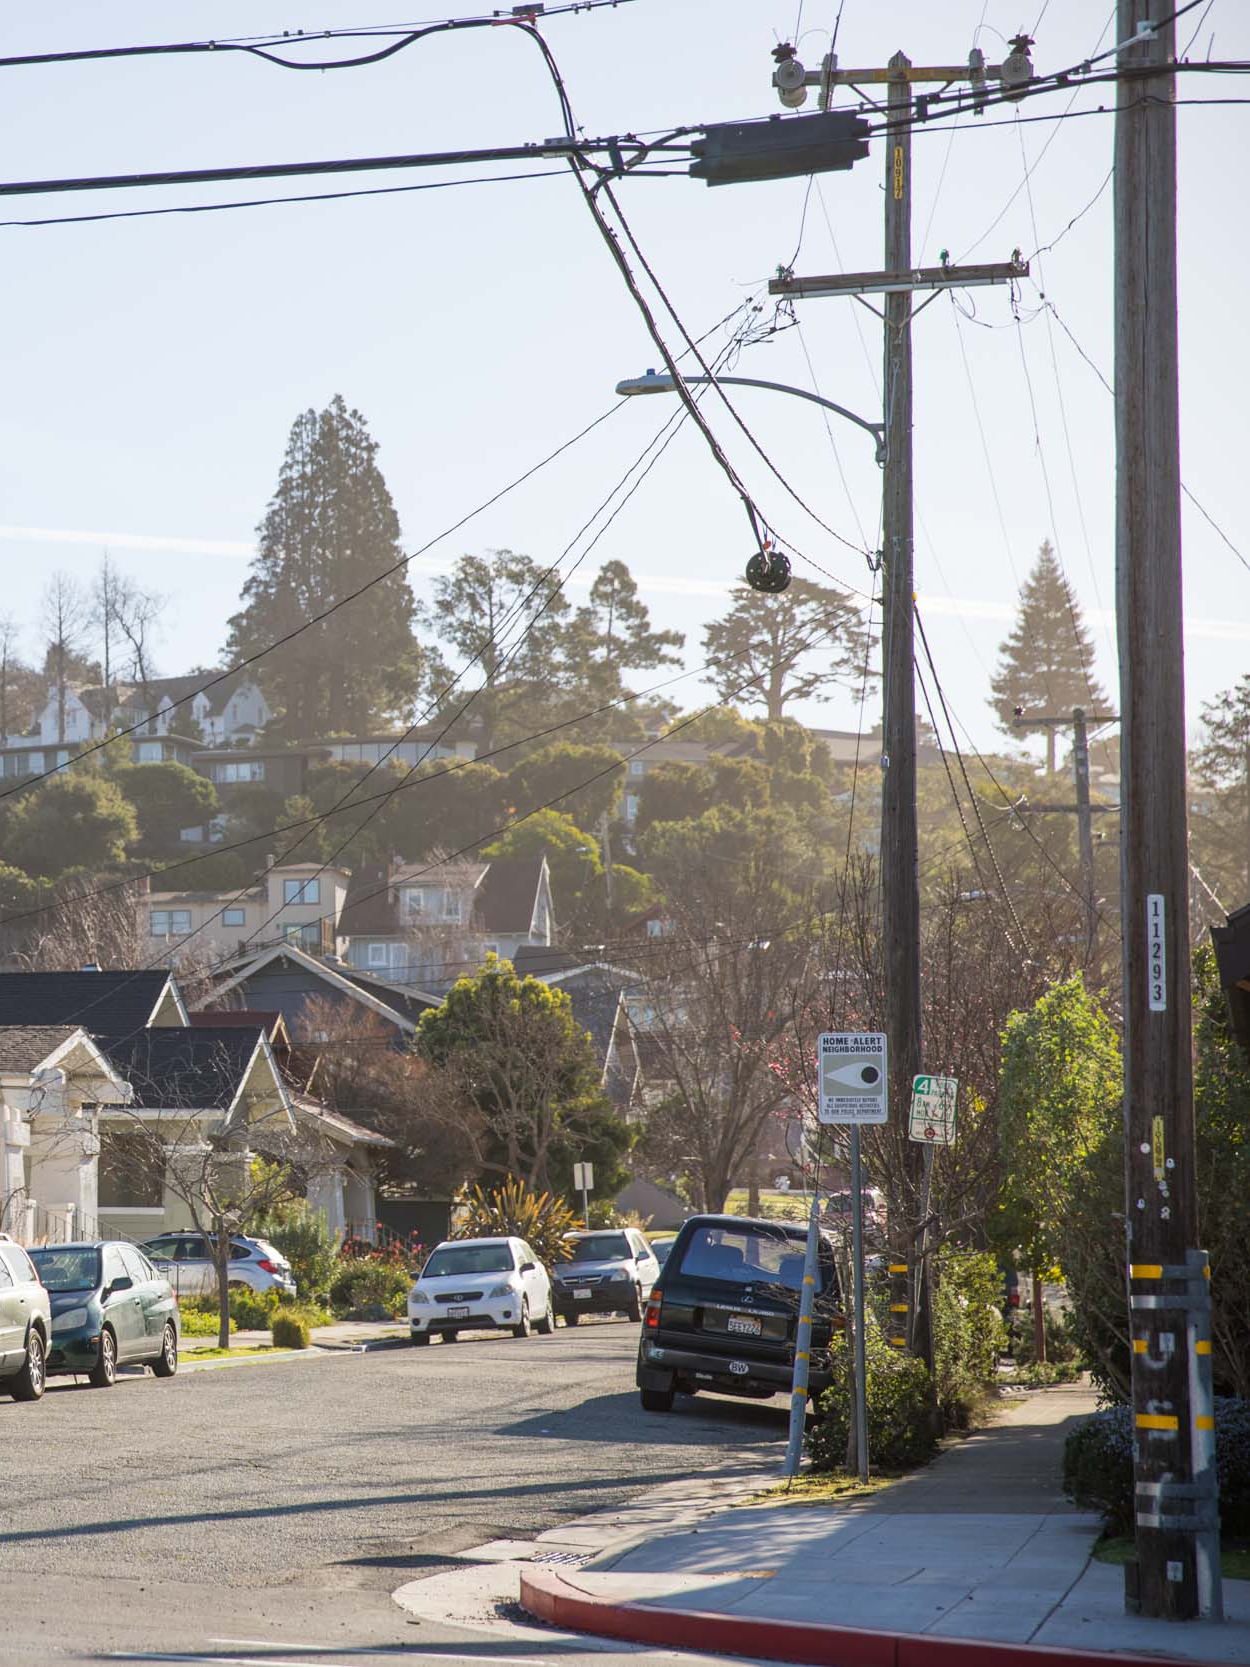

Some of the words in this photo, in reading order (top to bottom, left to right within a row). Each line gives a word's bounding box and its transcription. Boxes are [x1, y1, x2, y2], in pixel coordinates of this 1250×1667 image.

[1152, 901, 1162, 1001] 11293
[823, 1037, 849, 1045] HOME
[853, 1037, 882, 1045] ALERT
[917, 1079, 929, 1094] 4
[731, 1362, 747, 1373] BW
